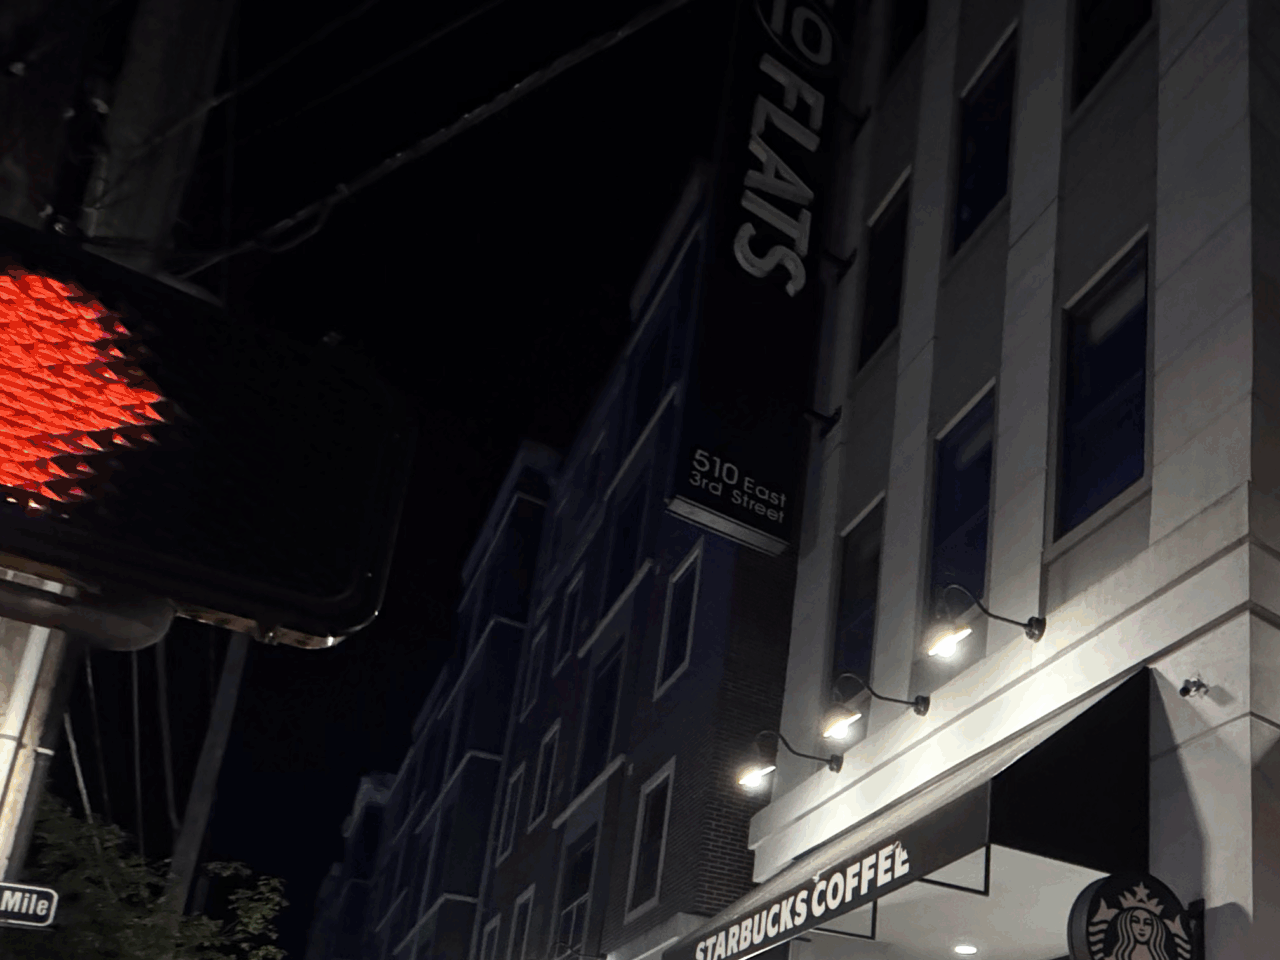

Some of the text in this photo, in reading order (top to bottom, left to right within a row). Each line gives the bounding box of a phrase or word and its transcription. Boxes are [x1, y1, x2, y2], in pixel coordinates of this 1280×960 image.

[733, 52, 825, 297] FLATS
[689, 470, 785, 523] 3rd Street
[692, 449, 787, 508] 510 East
[0, 890, 49, 916] Mile
[811, 841, 910, 918] COFFEE
